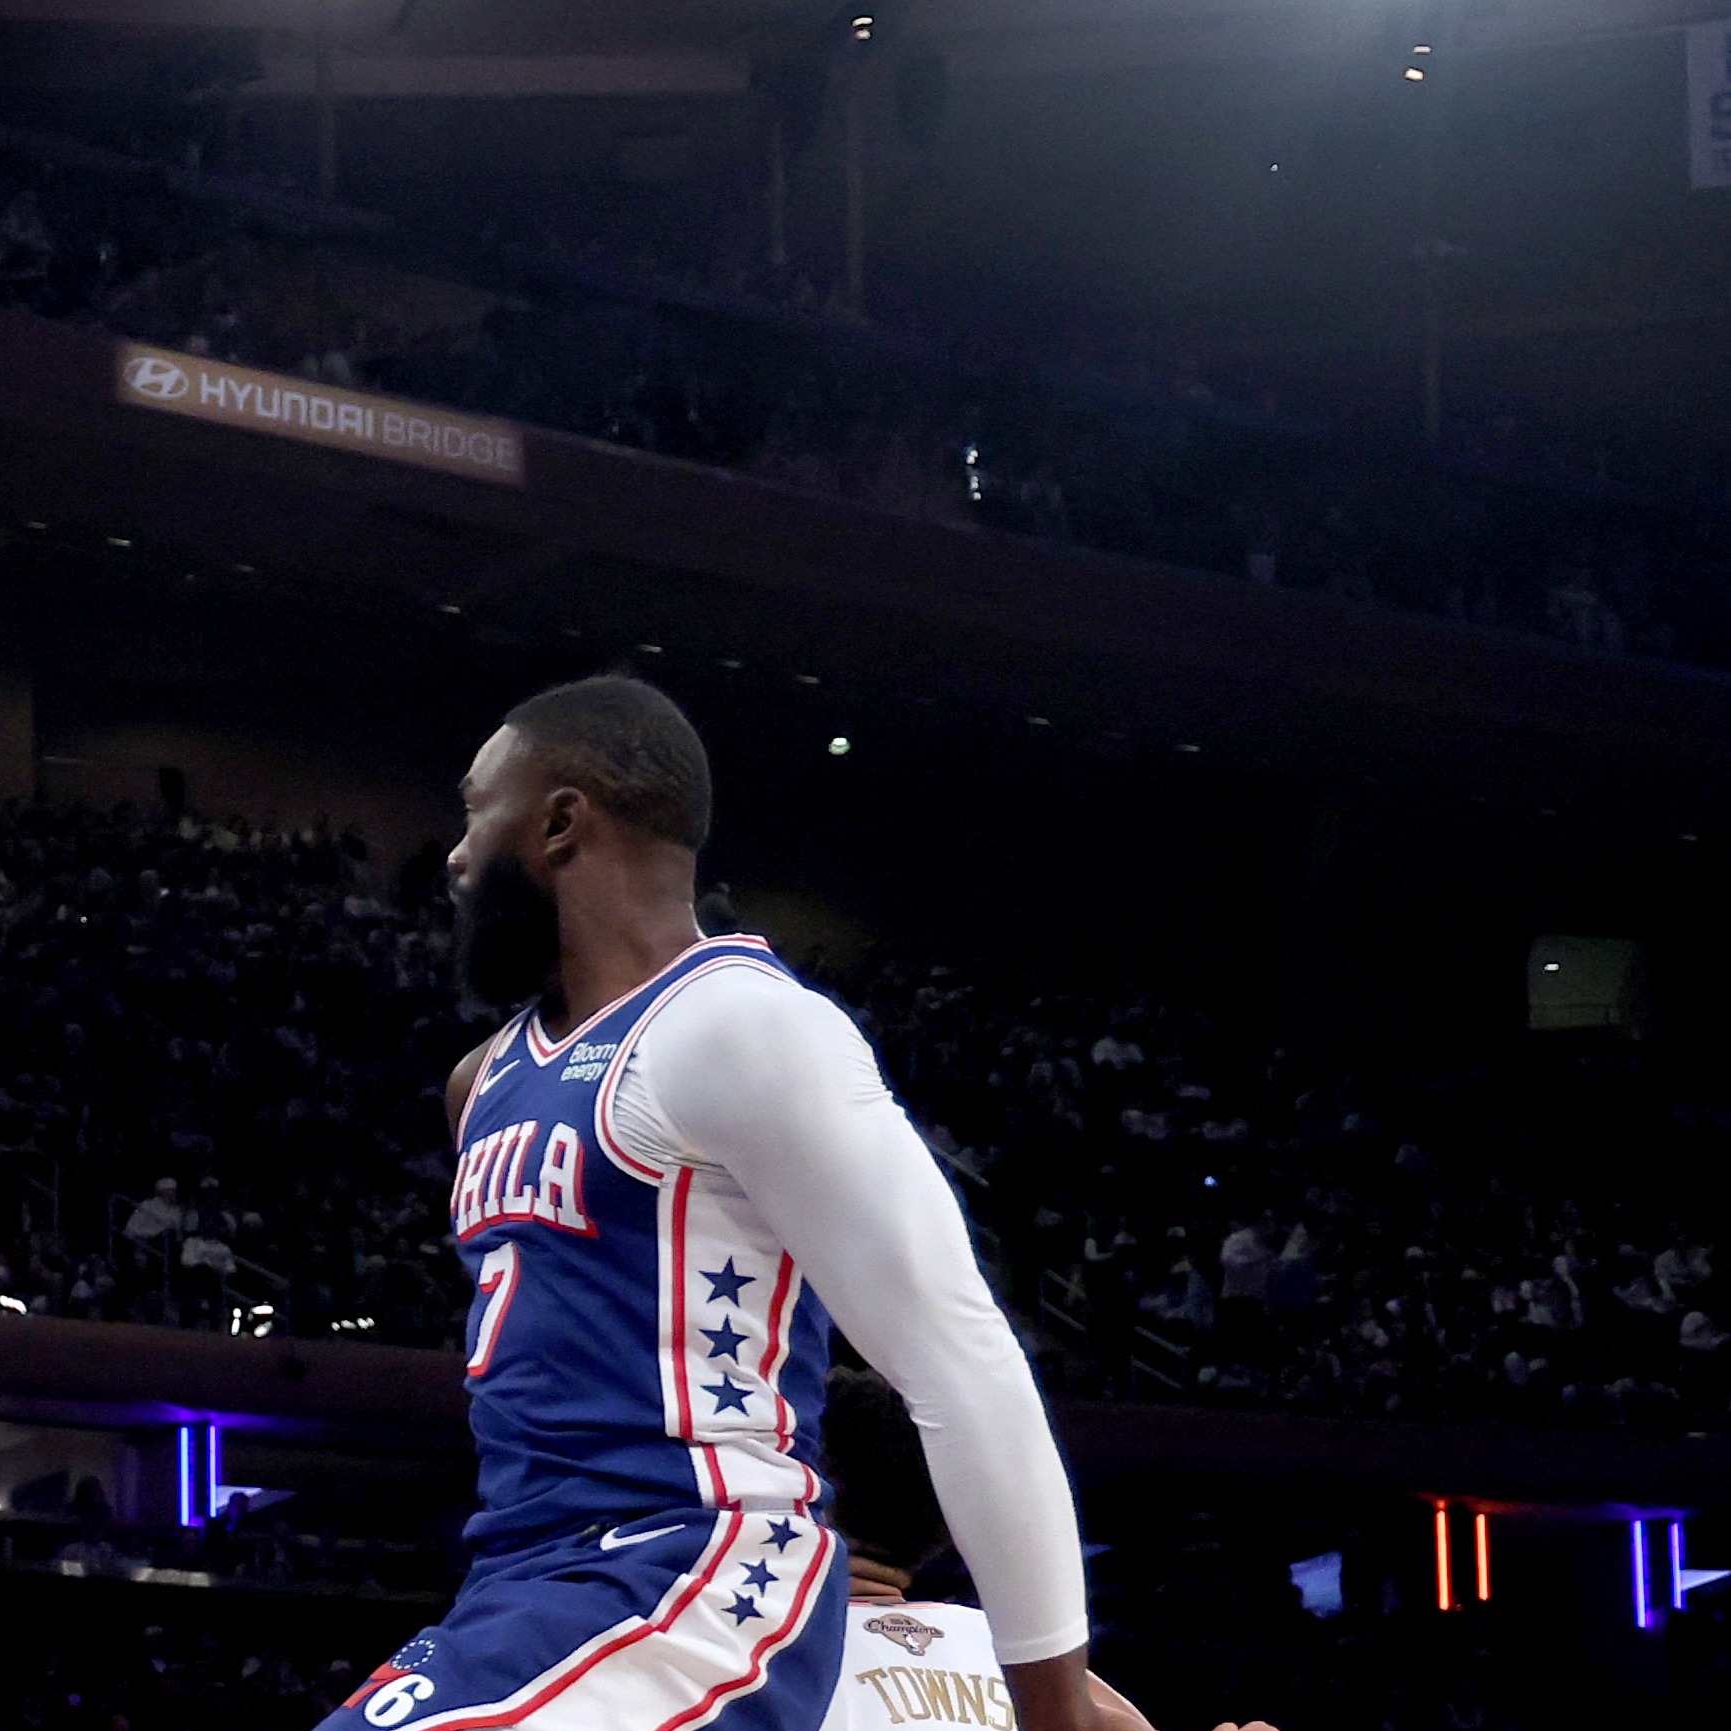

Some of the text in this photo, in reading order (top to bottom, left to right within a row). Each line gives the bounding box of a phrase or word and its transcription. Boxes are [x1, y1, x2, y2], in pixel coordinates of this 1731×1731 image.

[200, 373, 518, 472] HYUNDAI BRIDGE
[560, 1062, 609, 1082] energy
[569, 1042, 618, 1064] Bloom
[467, 1240, 521, 1377] 7
